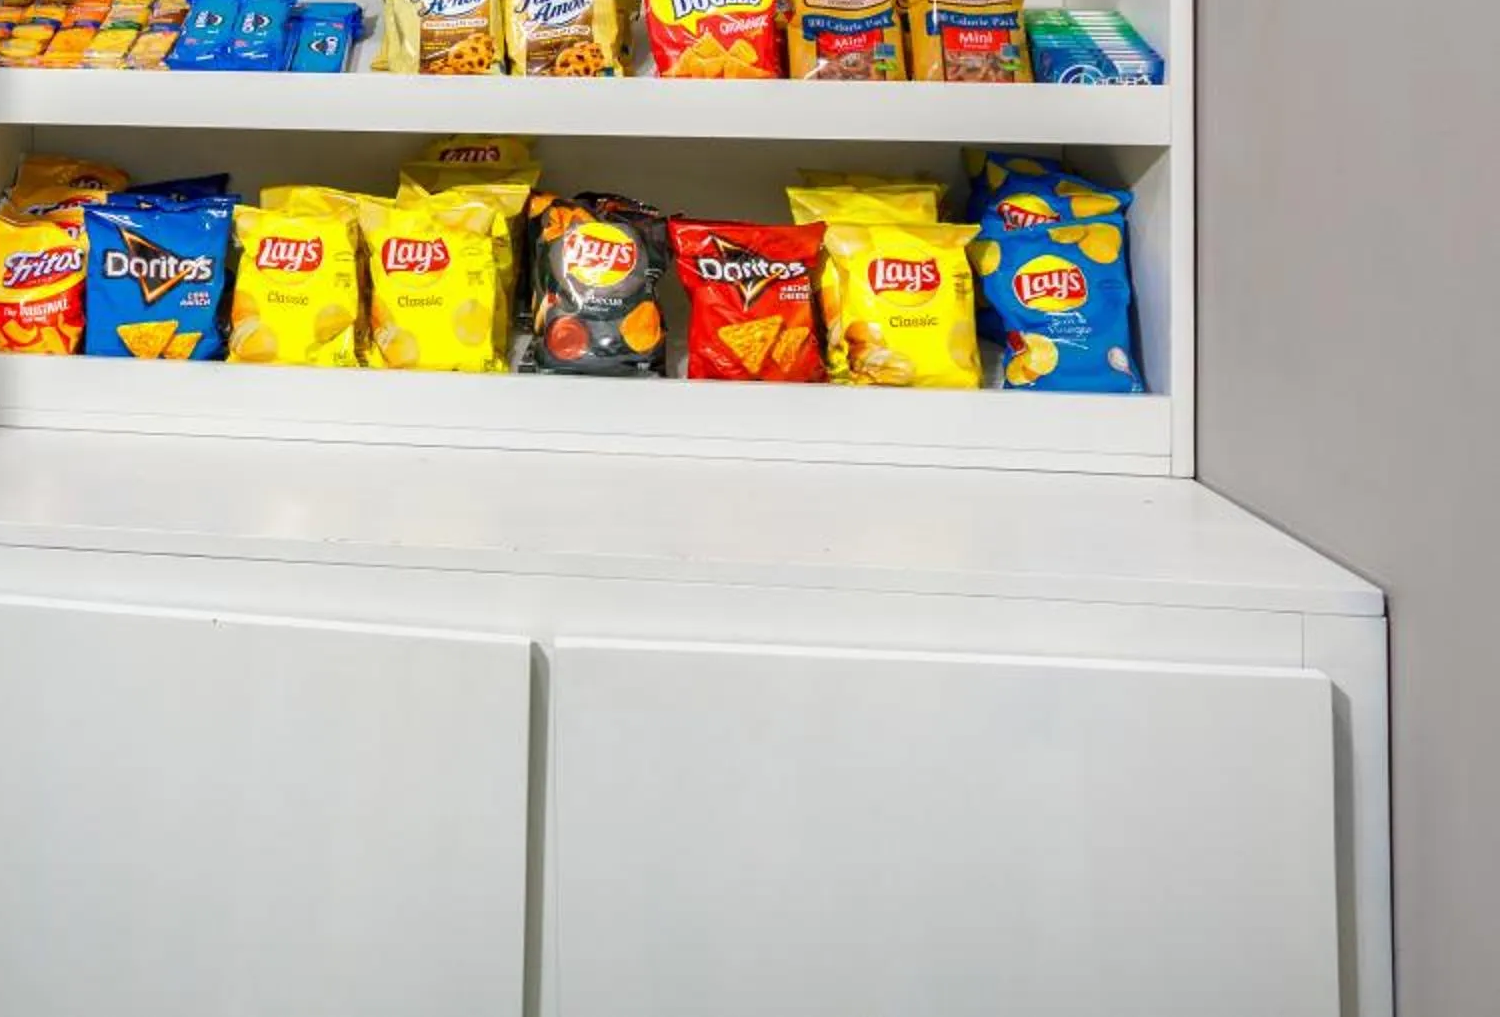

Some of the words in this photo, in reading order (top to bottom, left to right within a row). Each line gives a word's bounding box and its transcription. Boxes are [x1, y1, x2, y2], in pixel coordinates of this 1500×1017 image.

[835, 35, 869, 48] Mini
[958, 32, 994, 45] Mini
[3, 249, 86, 286] Fritos
[105, 251, 213, 280] Doritos
[698, 258, 807, 282] Doritos
